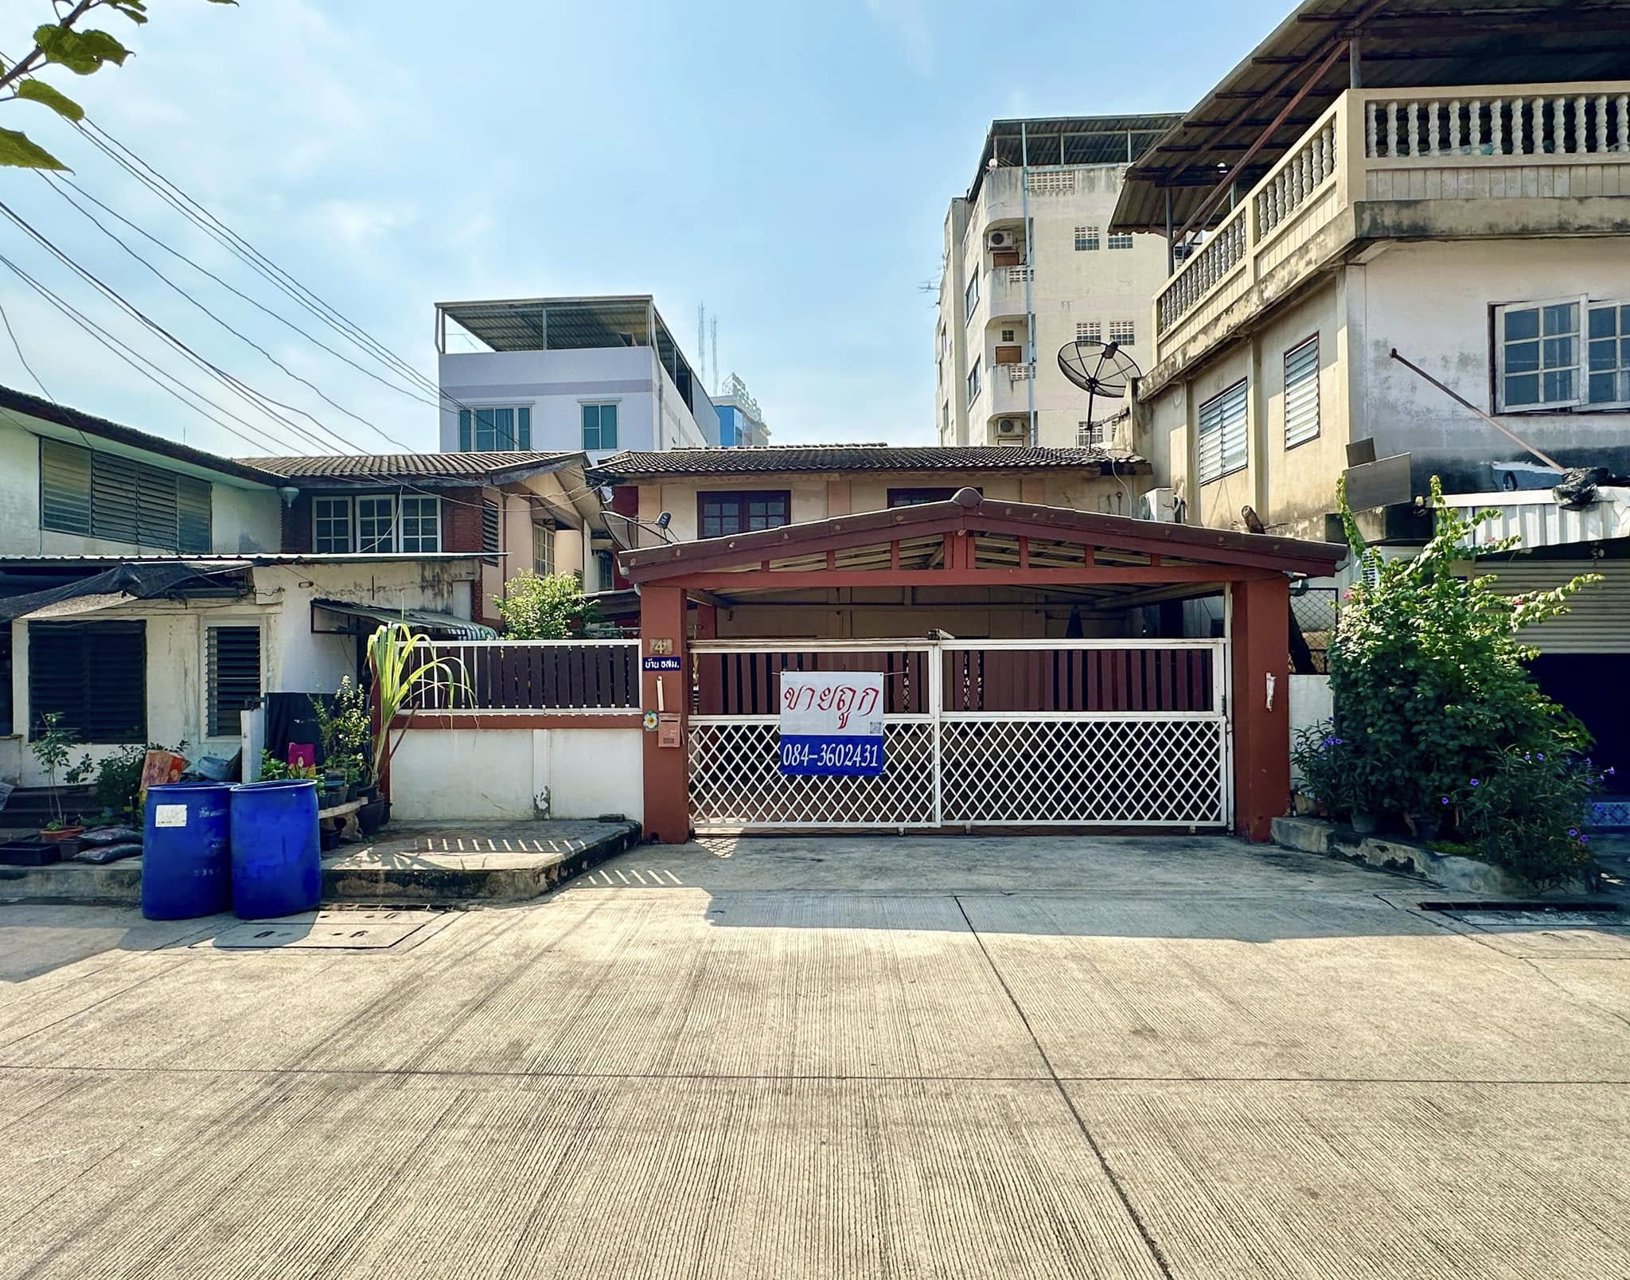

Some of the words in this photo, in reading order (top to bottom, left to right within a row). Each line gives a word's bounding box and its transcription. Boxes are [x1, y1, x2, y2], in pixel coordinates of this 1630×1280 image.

[645, 658, 660, 669] บ้าน
[660, 659, 680, 669] อสม.
[783, 684, 880, 730] ขายถูก
[783, 743, 879, 767] 084-3602431
